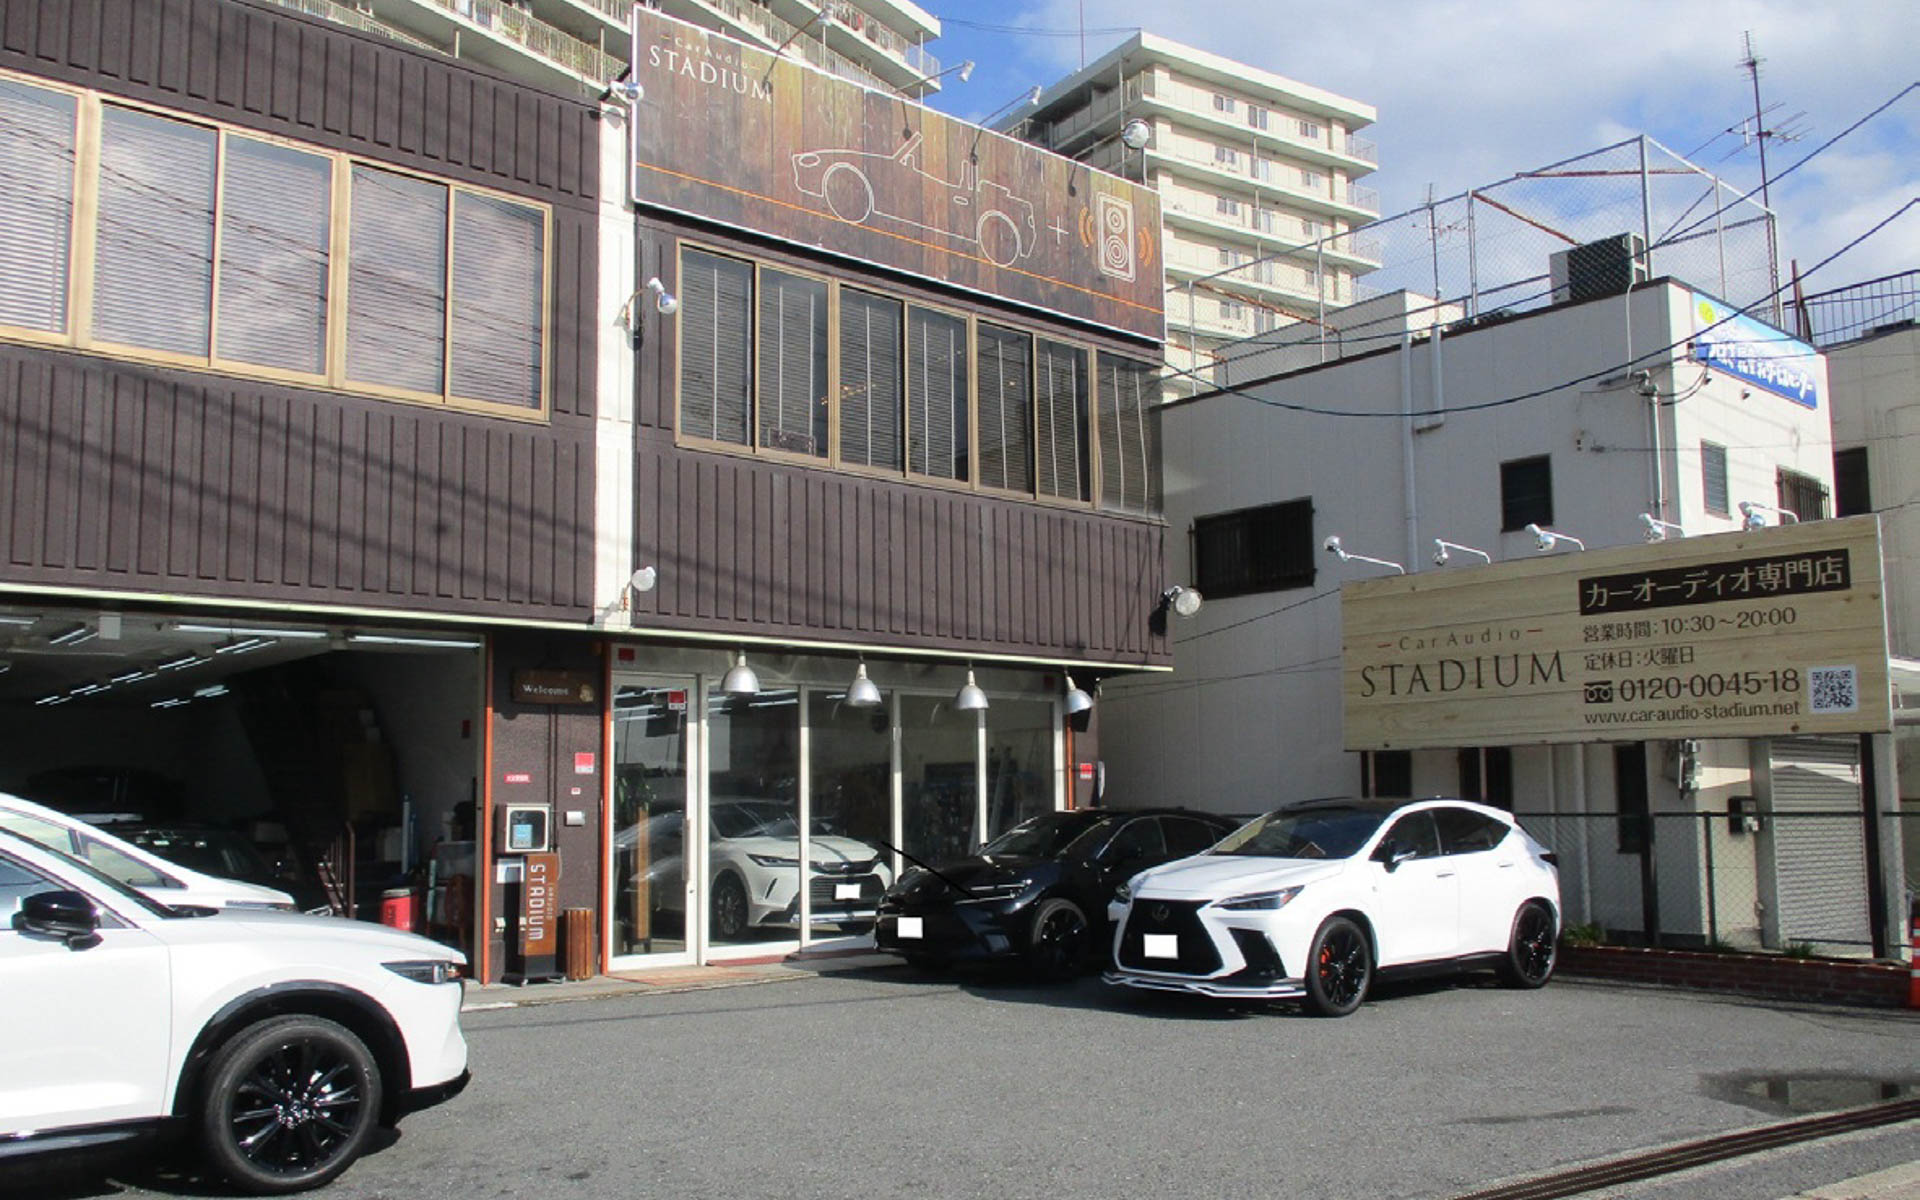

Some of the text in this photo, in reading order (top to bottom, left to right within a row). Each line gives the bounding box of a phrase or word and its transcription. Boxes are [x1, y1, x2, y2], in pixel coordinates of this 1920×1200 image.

[648, 44, 772, 104] STADIUM
[1585, 556, 1843, 609] カーオーディオ専門店
[522, 684, 569, 696] Welcome
[1361, 649, 1567, 698] STADIUM
[1584, 701, 1801, 724] www.car-audio-stadium.net
[528, 864, 546, 940] STADIUM
